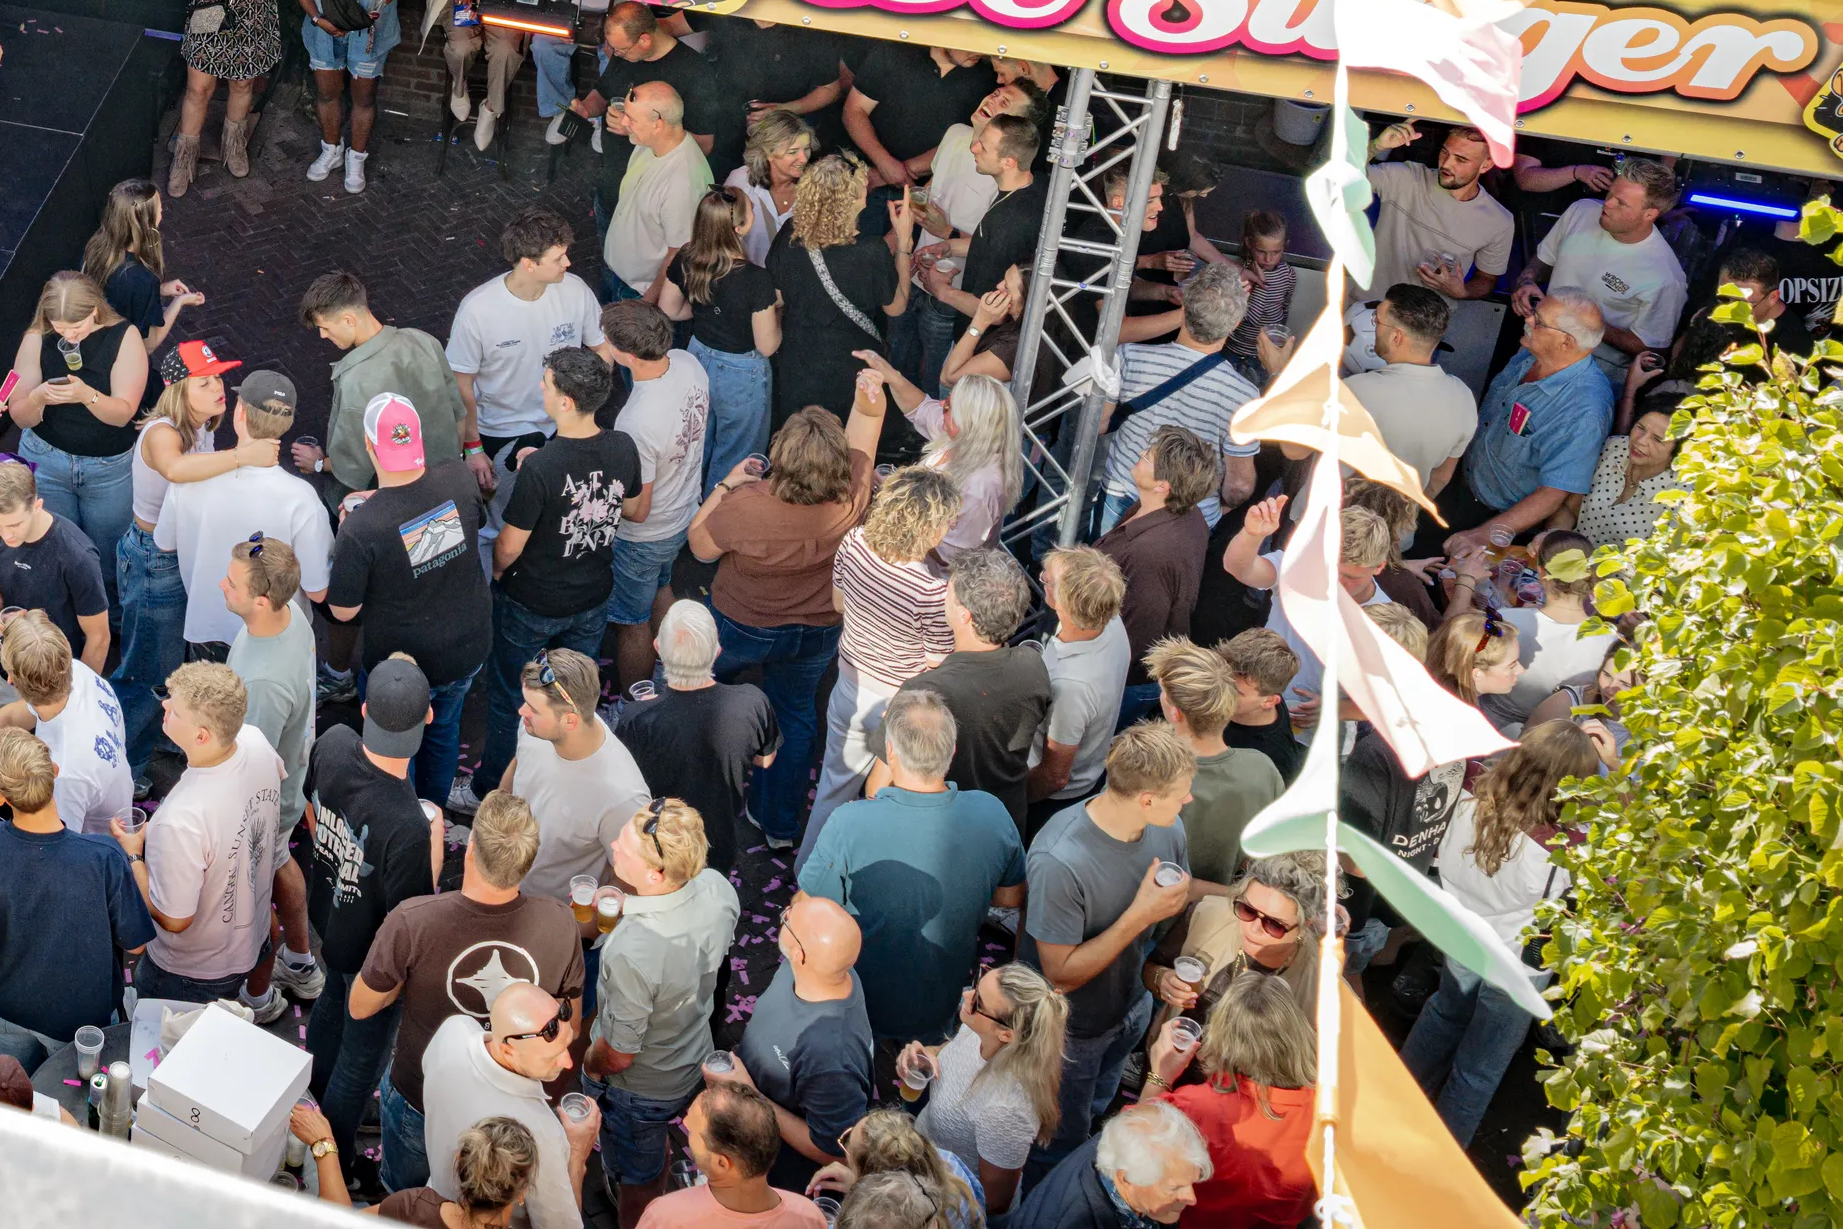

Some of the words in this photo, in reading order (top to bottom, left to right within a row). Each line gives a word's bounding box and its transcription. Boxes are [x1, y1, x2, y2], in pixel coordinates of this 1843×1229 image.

[1779, 276, 1843, 304] OPSIZ
[412, 542, 468, 579] patagonia
[1392, 822, 1447, 849] DENHA
